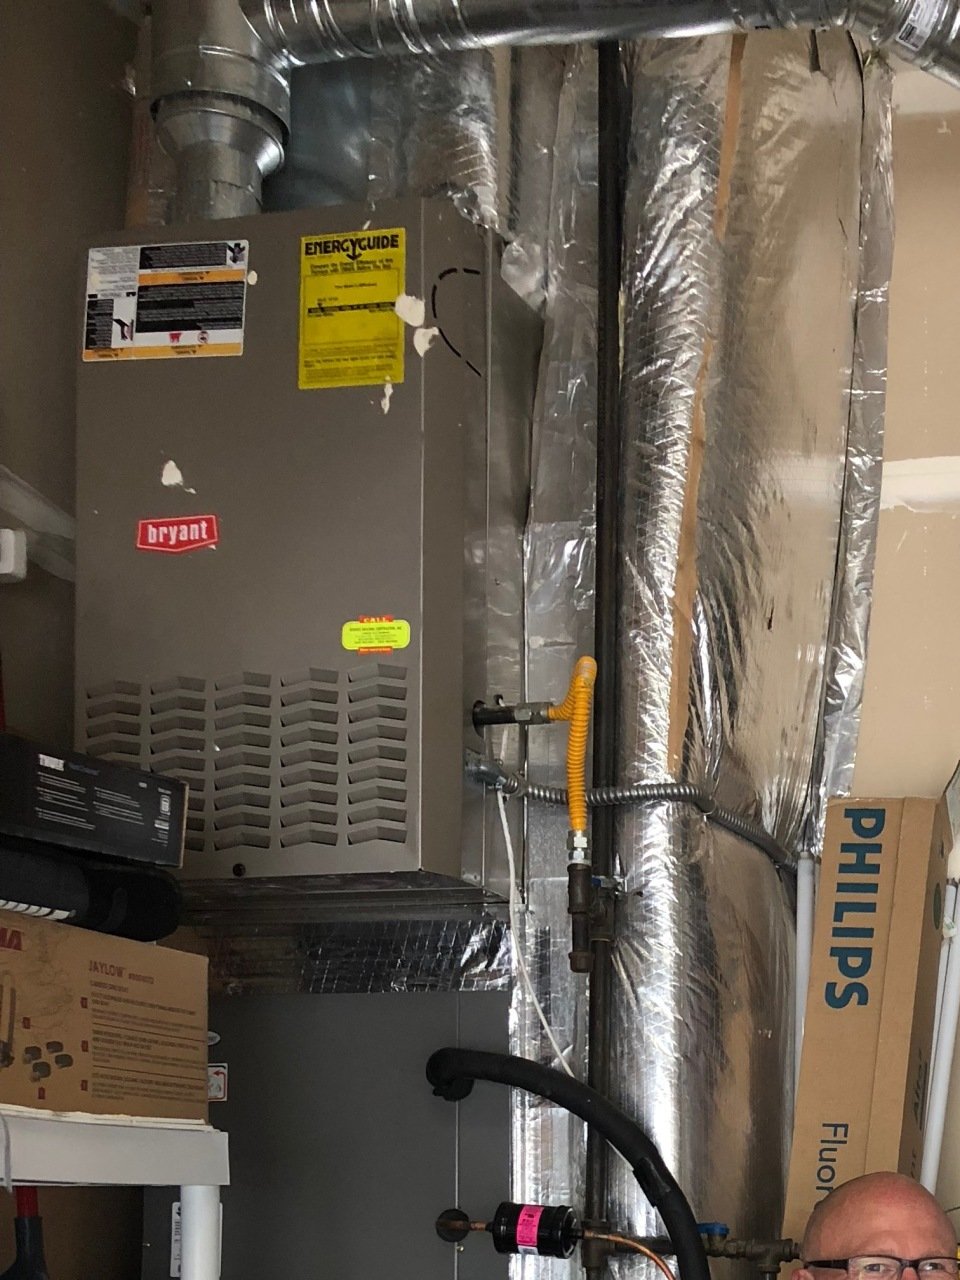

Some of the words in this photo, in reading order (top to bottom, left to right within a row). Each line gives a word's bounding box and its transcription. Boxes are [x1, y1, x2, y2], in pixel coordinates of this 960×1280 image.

[304, 235, 400, 258] ENERGYGUIDE
[147, 521, 208, 545] bryant
[824, 807, 887, 1010] PHILIPS
